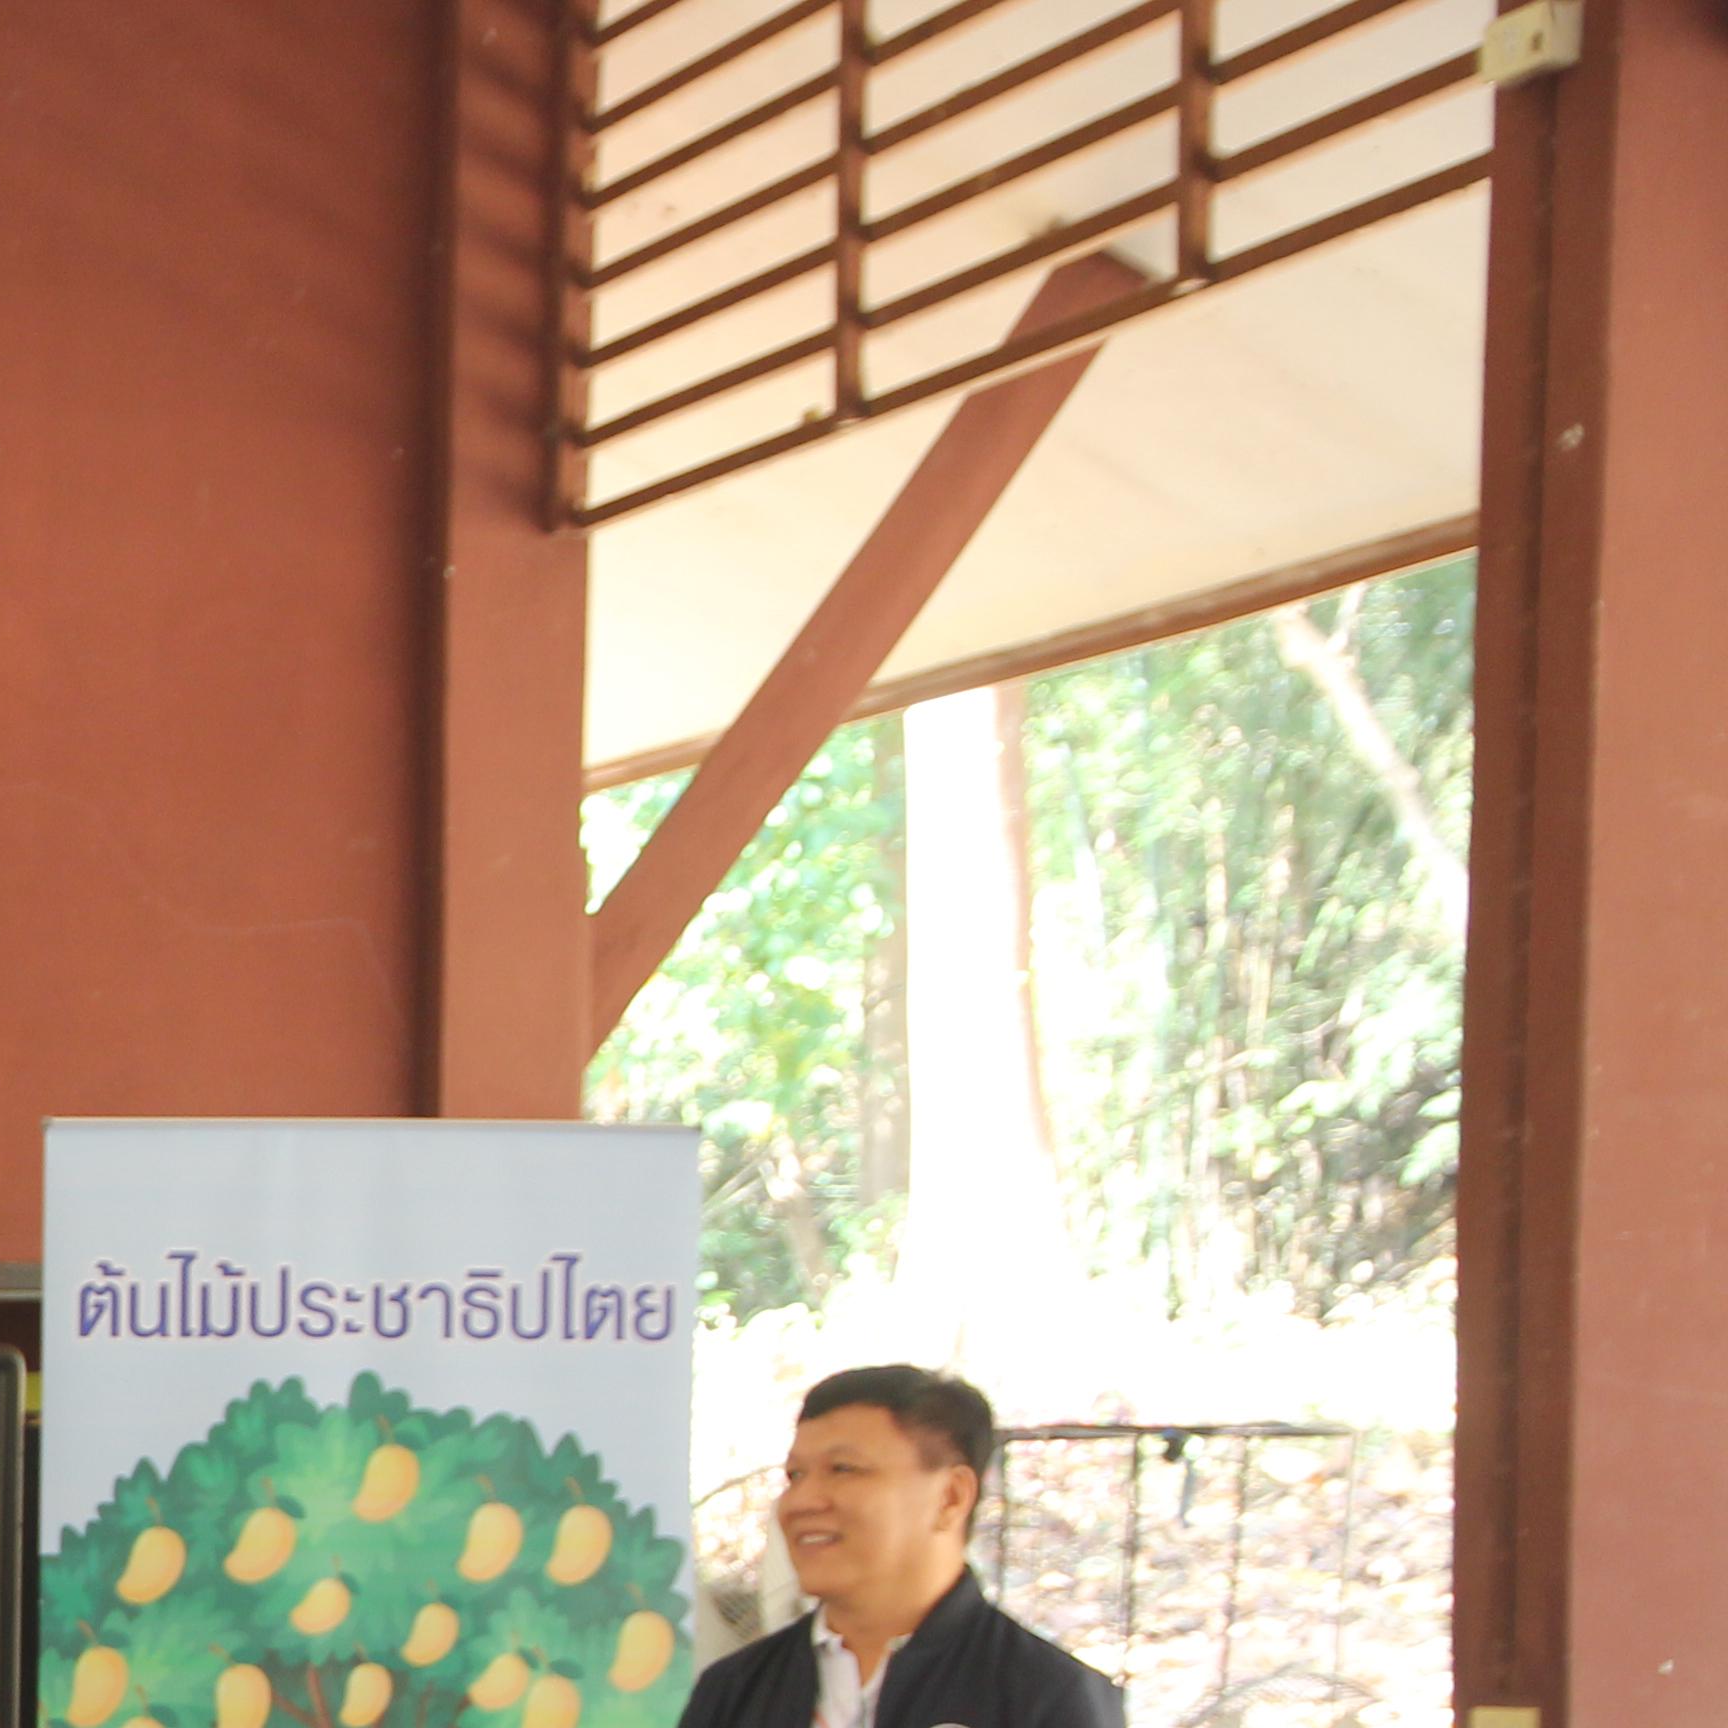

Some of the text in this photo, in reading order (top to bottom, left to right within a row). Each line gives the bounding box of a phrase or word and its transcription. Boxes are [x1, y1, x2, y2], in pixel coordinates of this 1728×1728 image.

[76, 1249, 676, 1341] ต้นไม้ประชาธิปไตย
